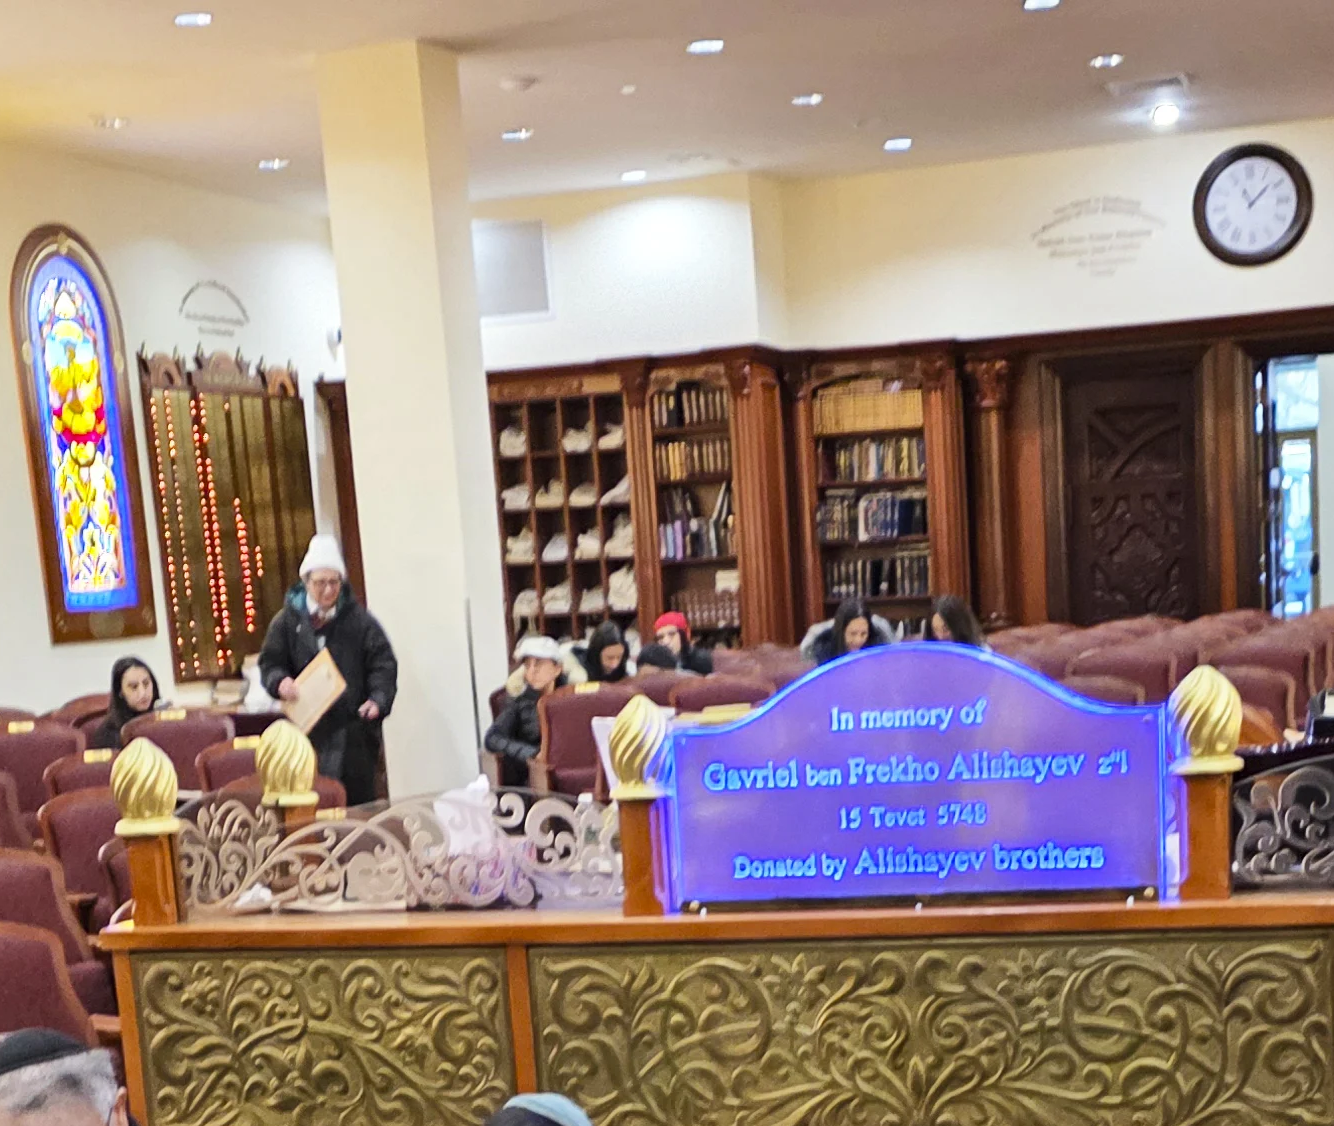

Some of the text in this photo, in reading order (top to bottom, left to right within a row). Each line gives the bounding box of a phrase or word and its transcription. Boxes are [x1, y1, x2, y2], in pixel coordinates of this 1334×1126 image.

[830, 698, 987, 732] In memory of
[703, 759, 799, 791] Gavriel
[806, 763, 842, 787] ben
[848, 755, 940, 785] Frekho
[947, 750, 1085, 784] Alishayev
[839, 802, 988, 830] 15 Tevet 5748
[733, 841, 1105, 881] Donated by Alishayev brothers
